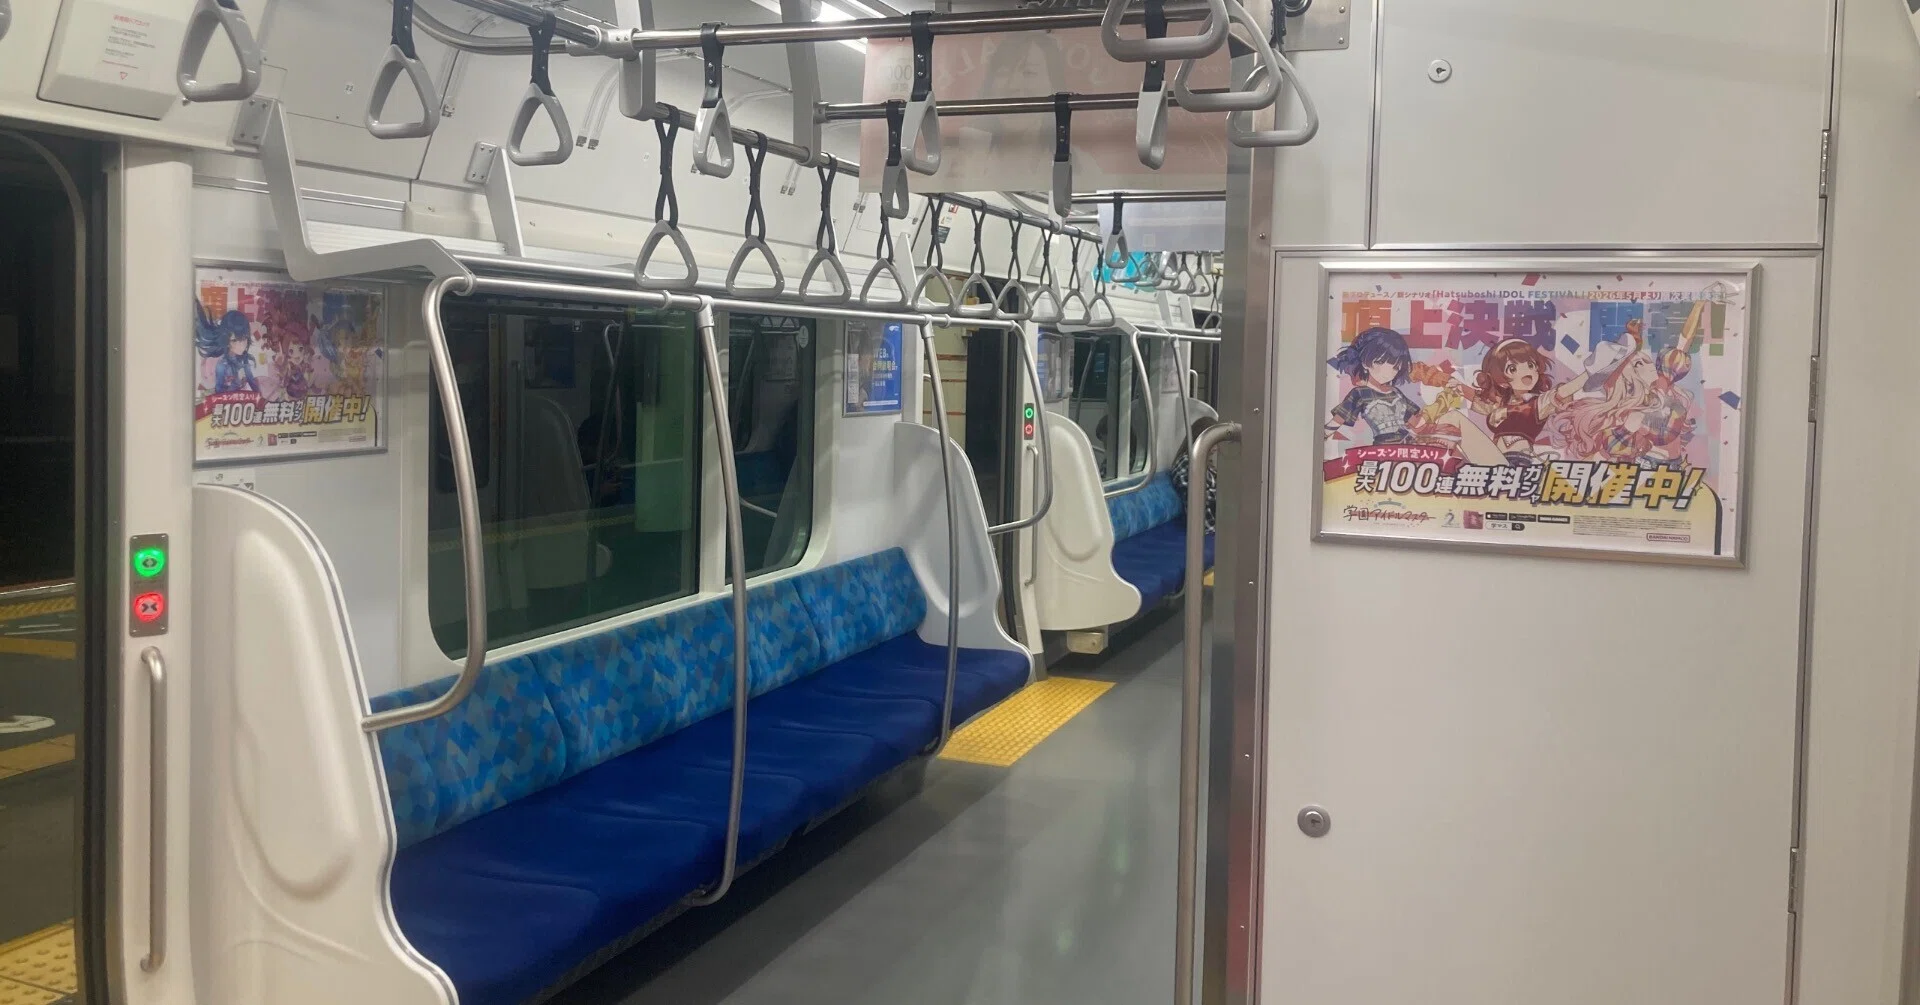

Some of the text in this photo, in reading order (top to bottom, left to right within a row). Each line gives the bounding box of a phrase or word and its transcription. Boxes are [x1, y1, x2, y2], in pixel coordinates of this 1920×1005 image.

[1500, 290, 1525, 298] IDOL
[1357, 447, 1439, 459] シーズン限定入り
